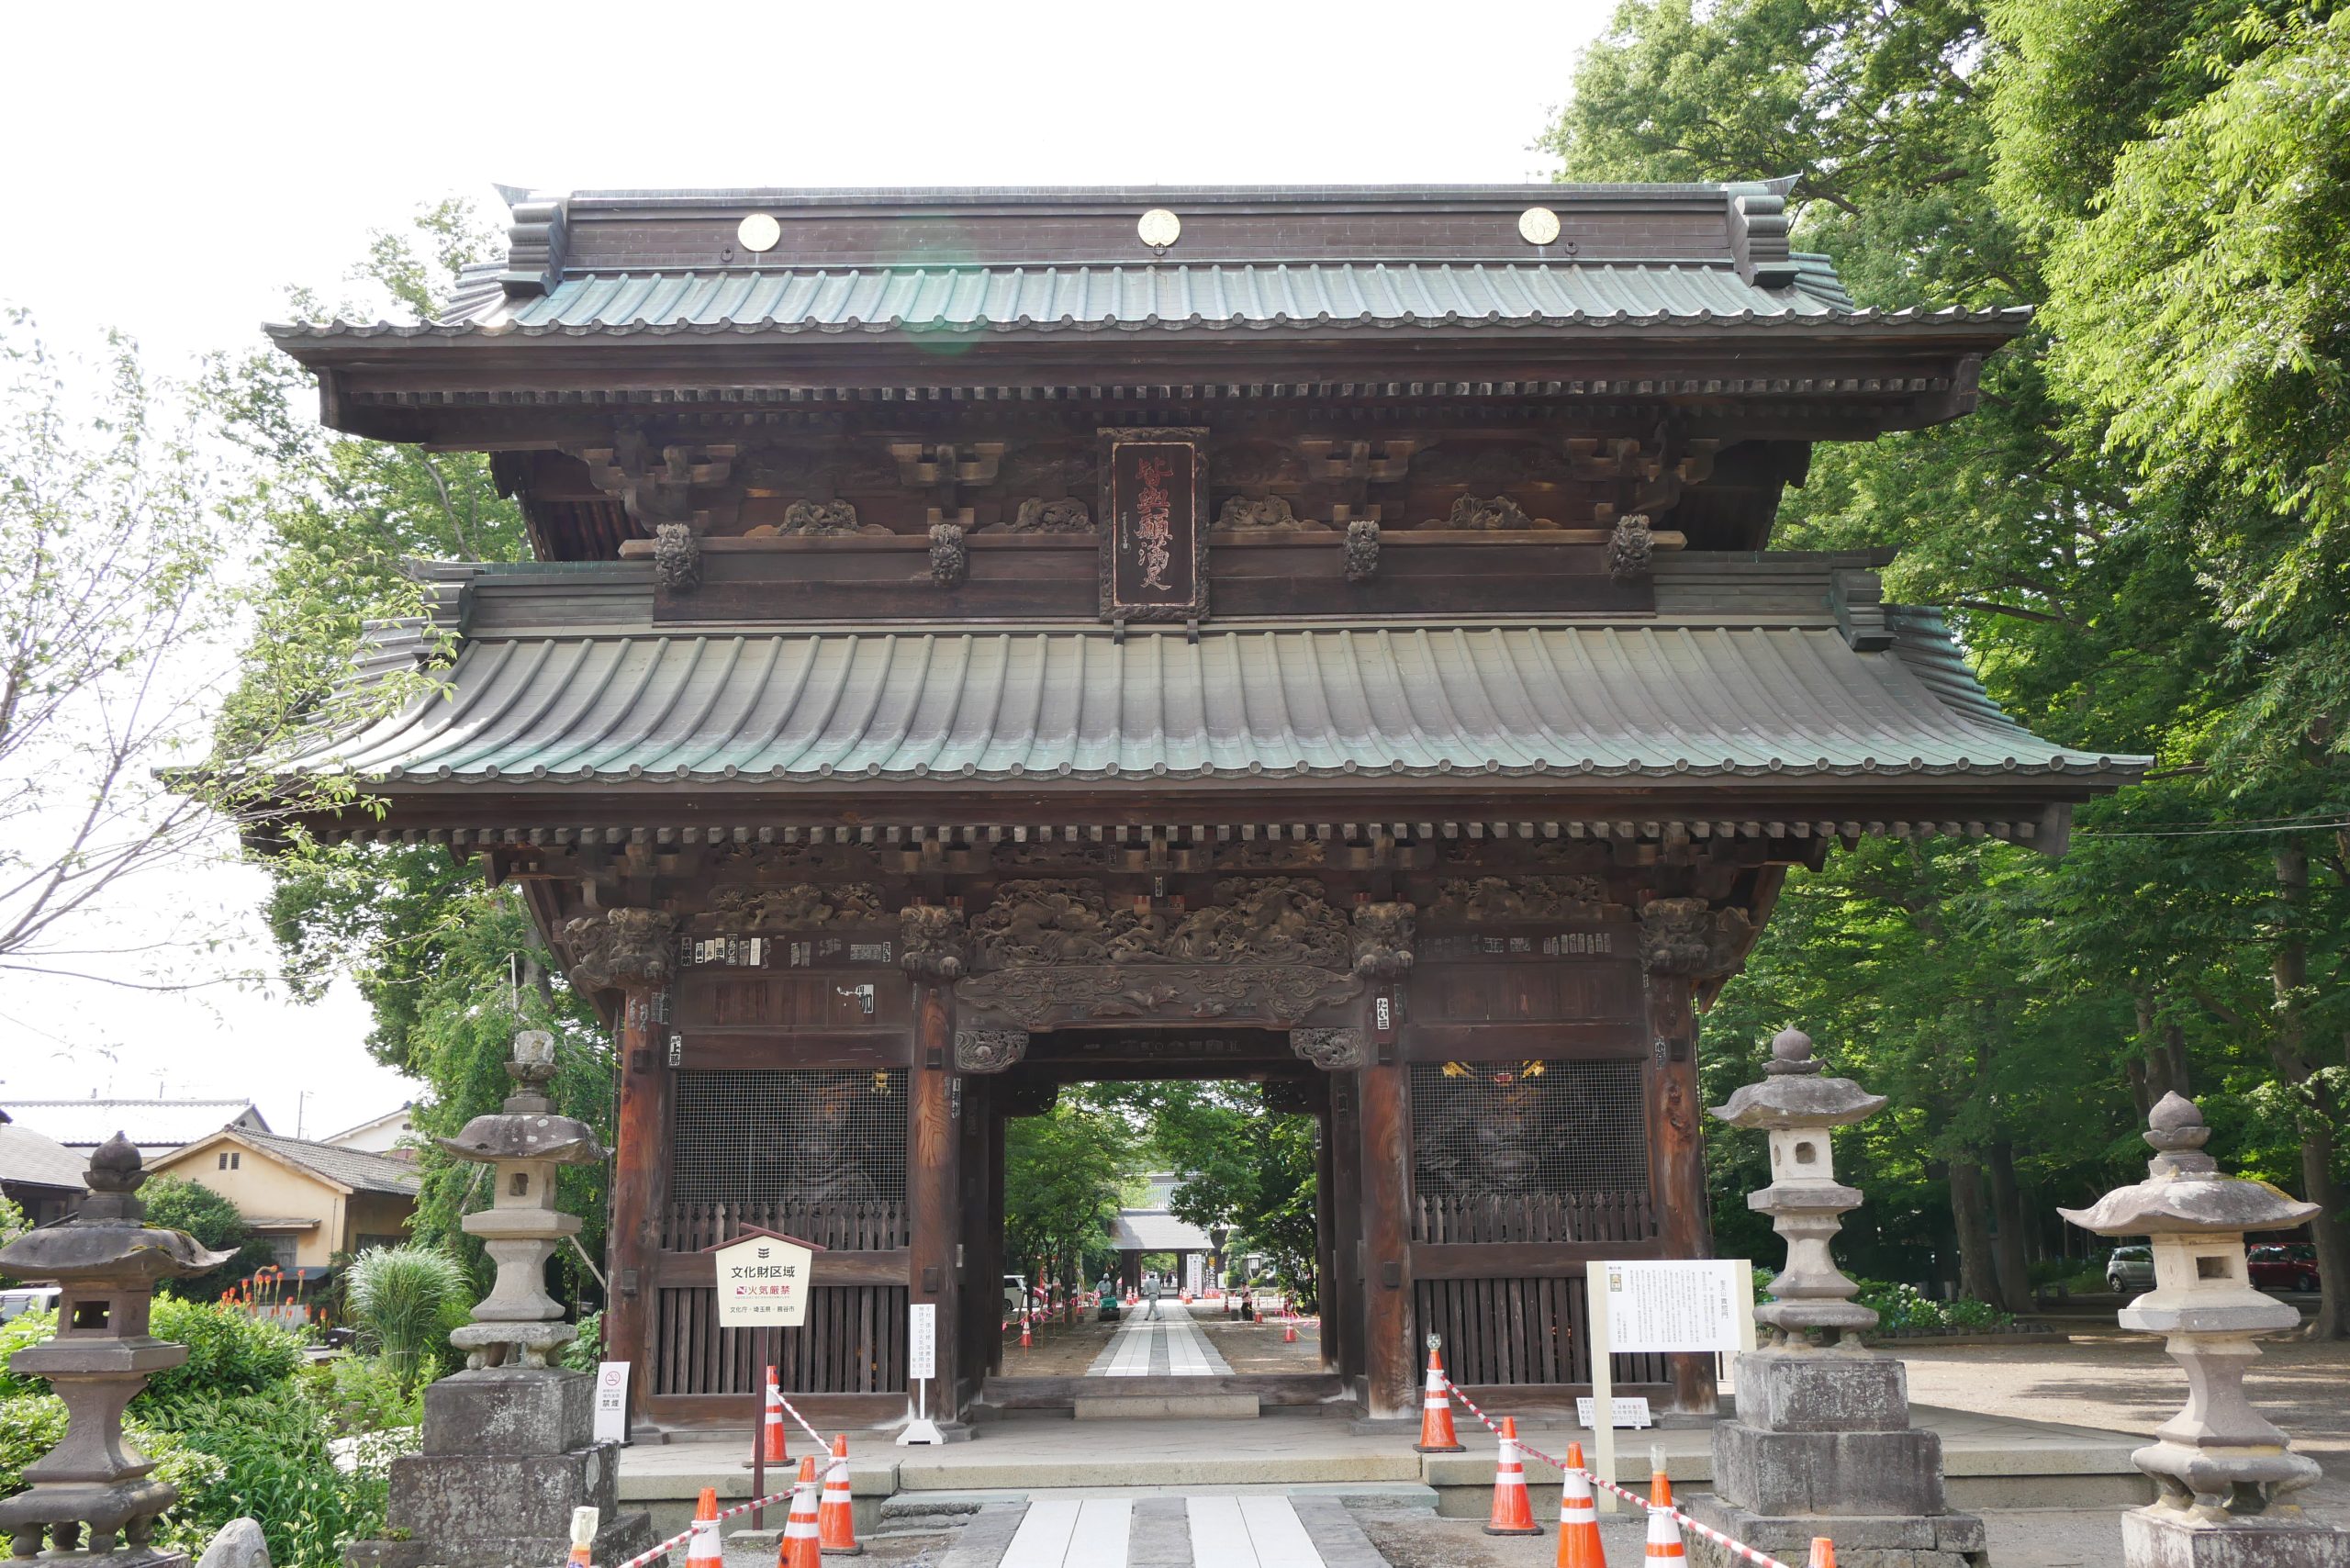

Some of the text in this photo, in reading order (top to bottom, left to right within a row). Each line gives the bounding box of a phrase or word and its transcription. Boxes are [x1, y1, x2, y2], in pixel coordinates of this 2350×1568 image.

[731, 1265, 796, 1279] 文化財区域
[748, 1285, 790, 1295] 火気厳禁
[602, 1399, 620, 1407] 禁煙
